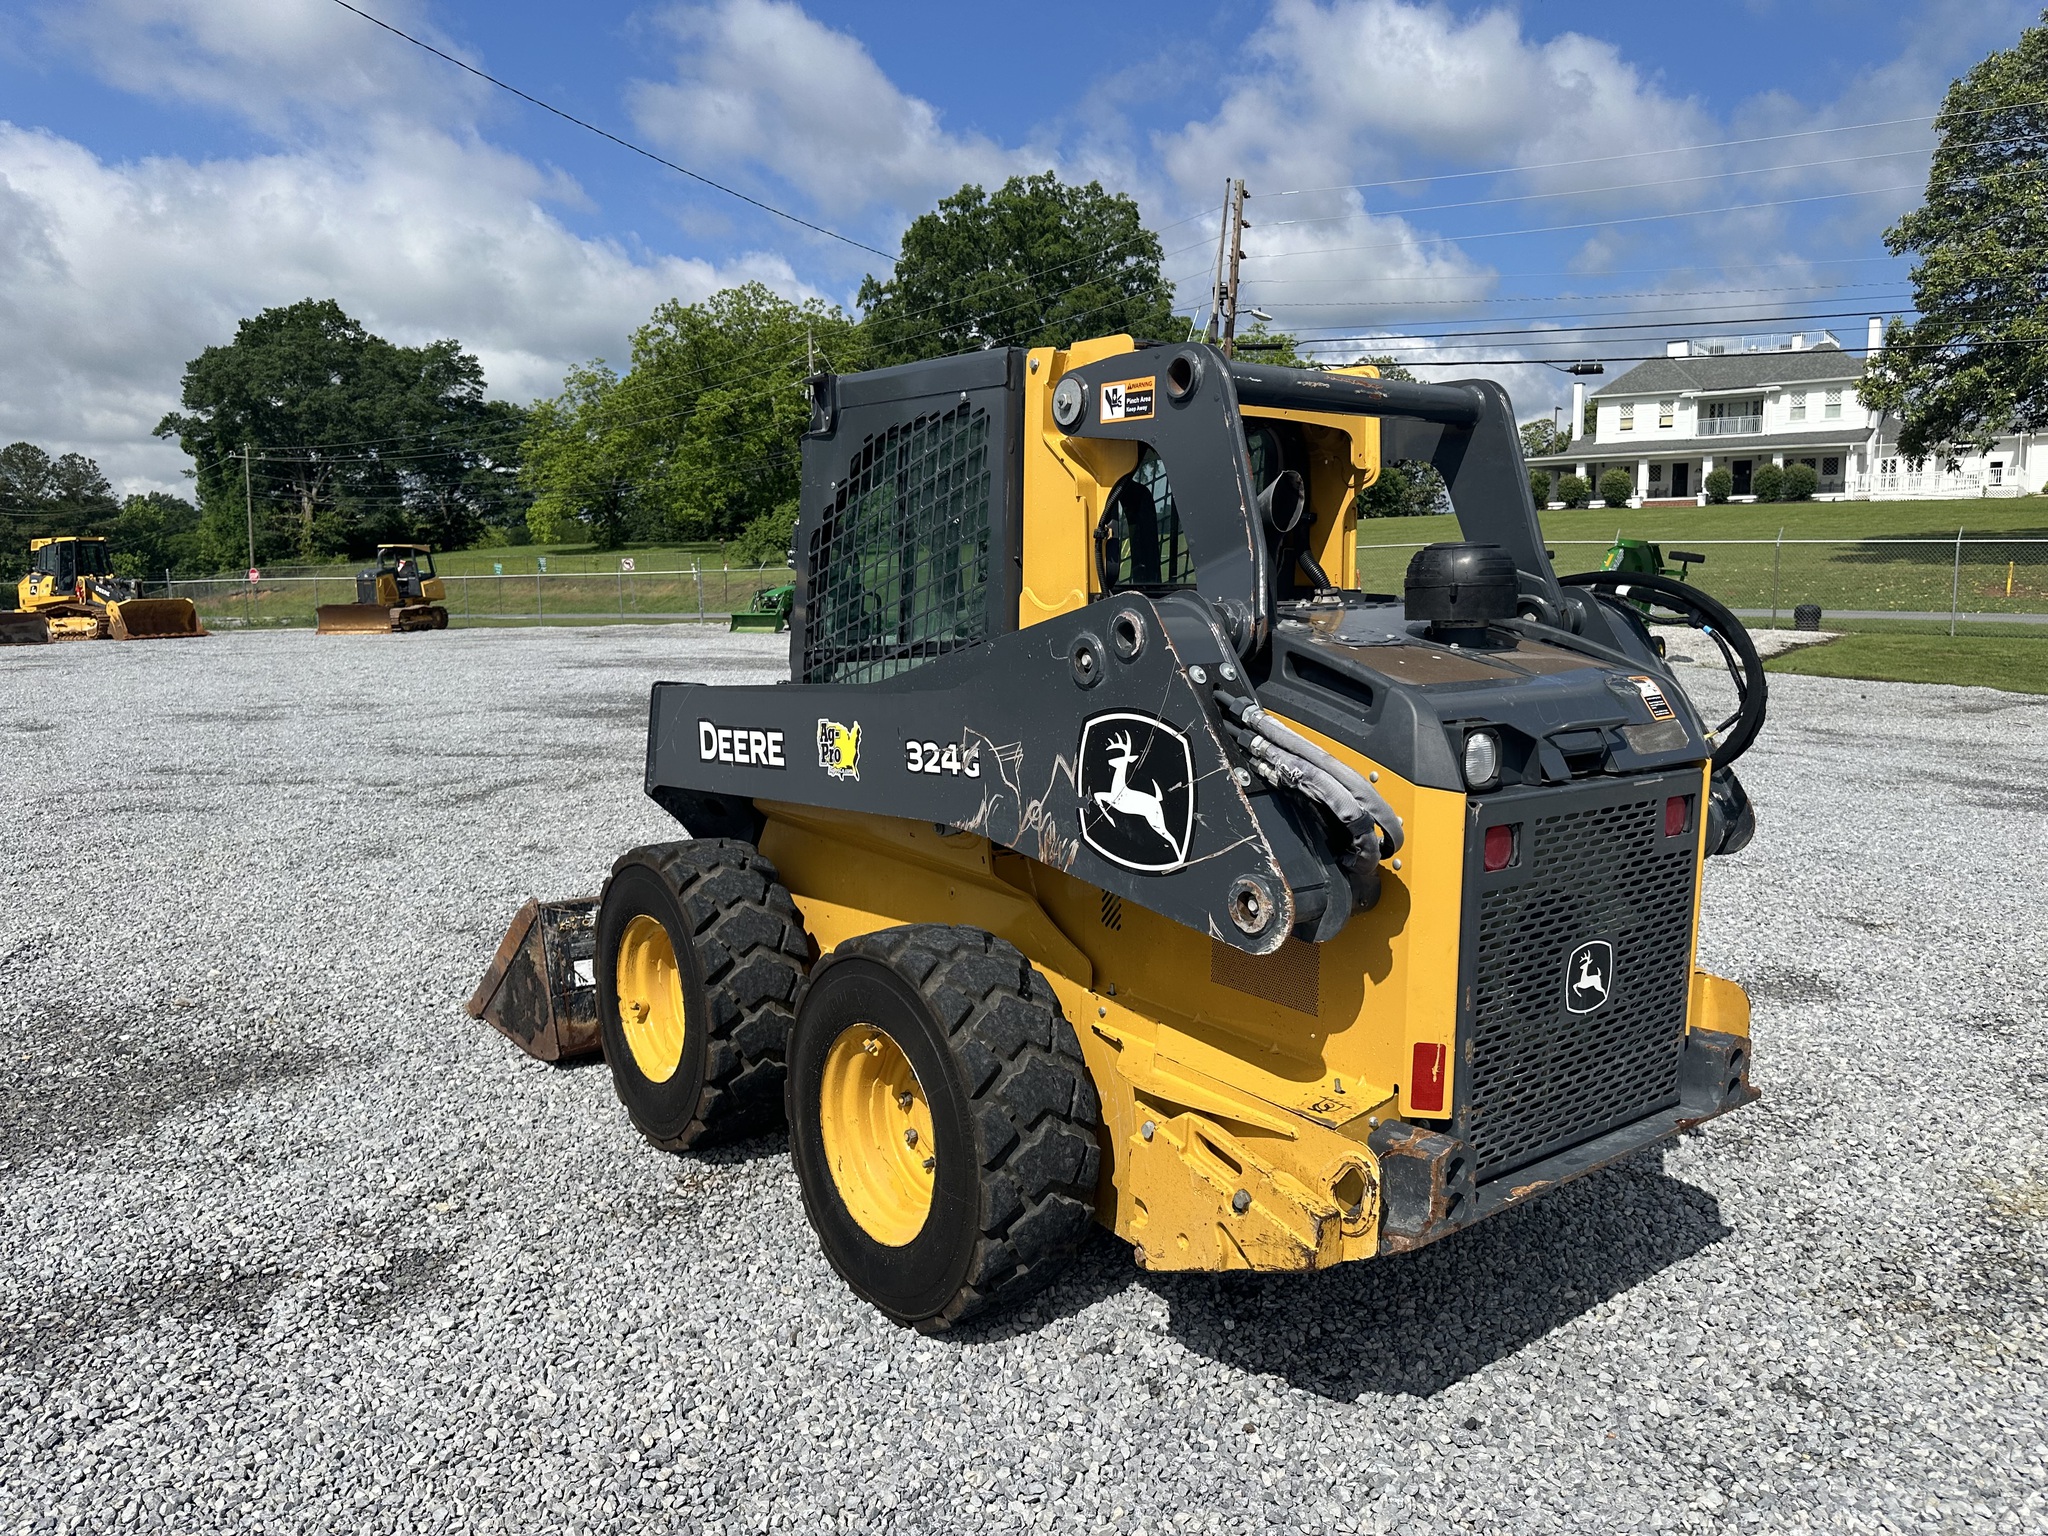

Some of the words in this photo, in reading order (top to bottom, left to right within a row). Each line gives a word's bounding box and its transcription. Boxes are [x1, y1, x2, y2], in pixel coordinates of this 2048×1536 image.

[1131, 381, 1152, 389] WARNING
[95, 585, 110, 597] DEERE
[698, 721, 786, 767] DEERE
[820, 723, 840, 746] Ag-
[821, 743, 842, 763] Pro
[905, 741, 981, 778] 324G
